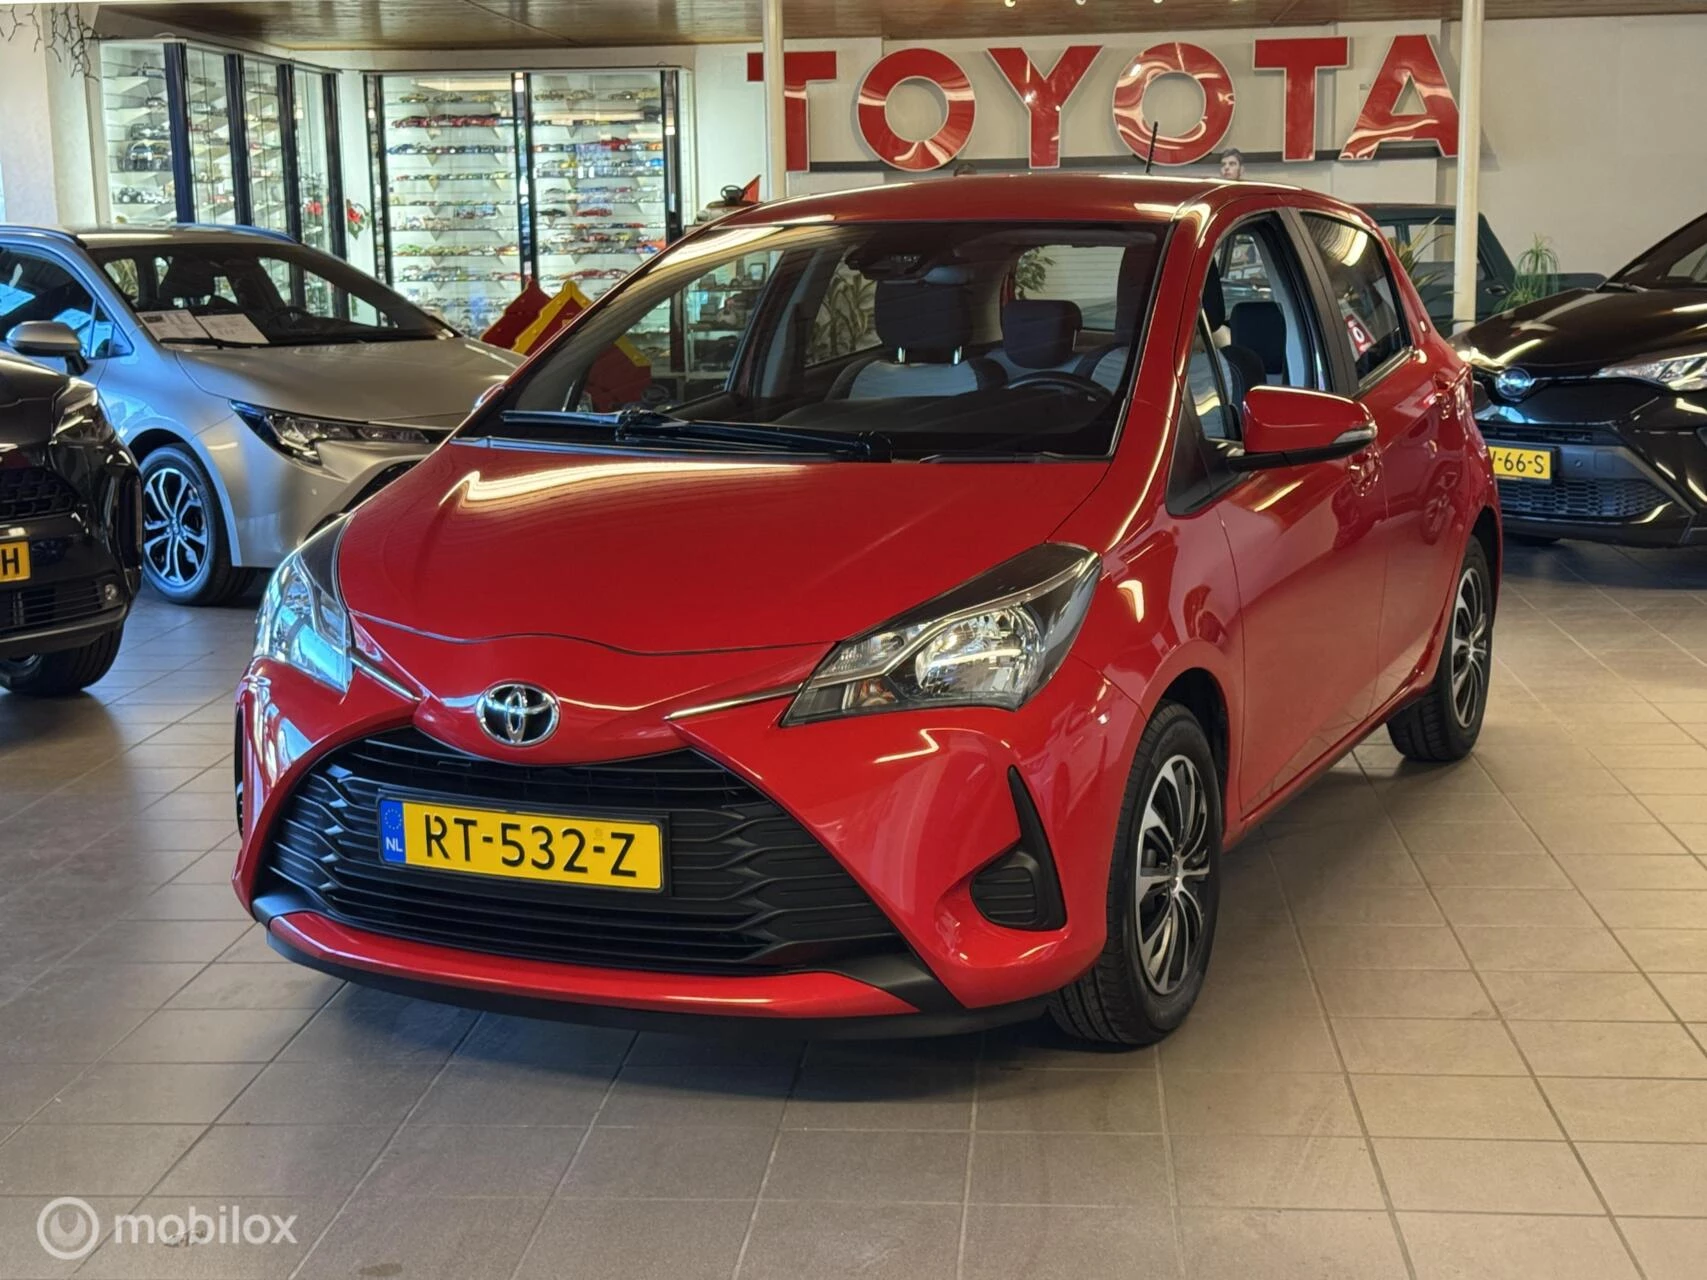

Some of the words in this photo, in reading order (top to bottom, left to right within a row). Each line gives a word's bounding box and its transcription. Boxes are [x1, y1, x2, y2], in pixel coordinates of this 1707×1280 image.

[747, 34, 1460, 172] TOYOTA
[385, 836, 404, 852] NL
[424, 813, 637, 878] RT-532-Z
